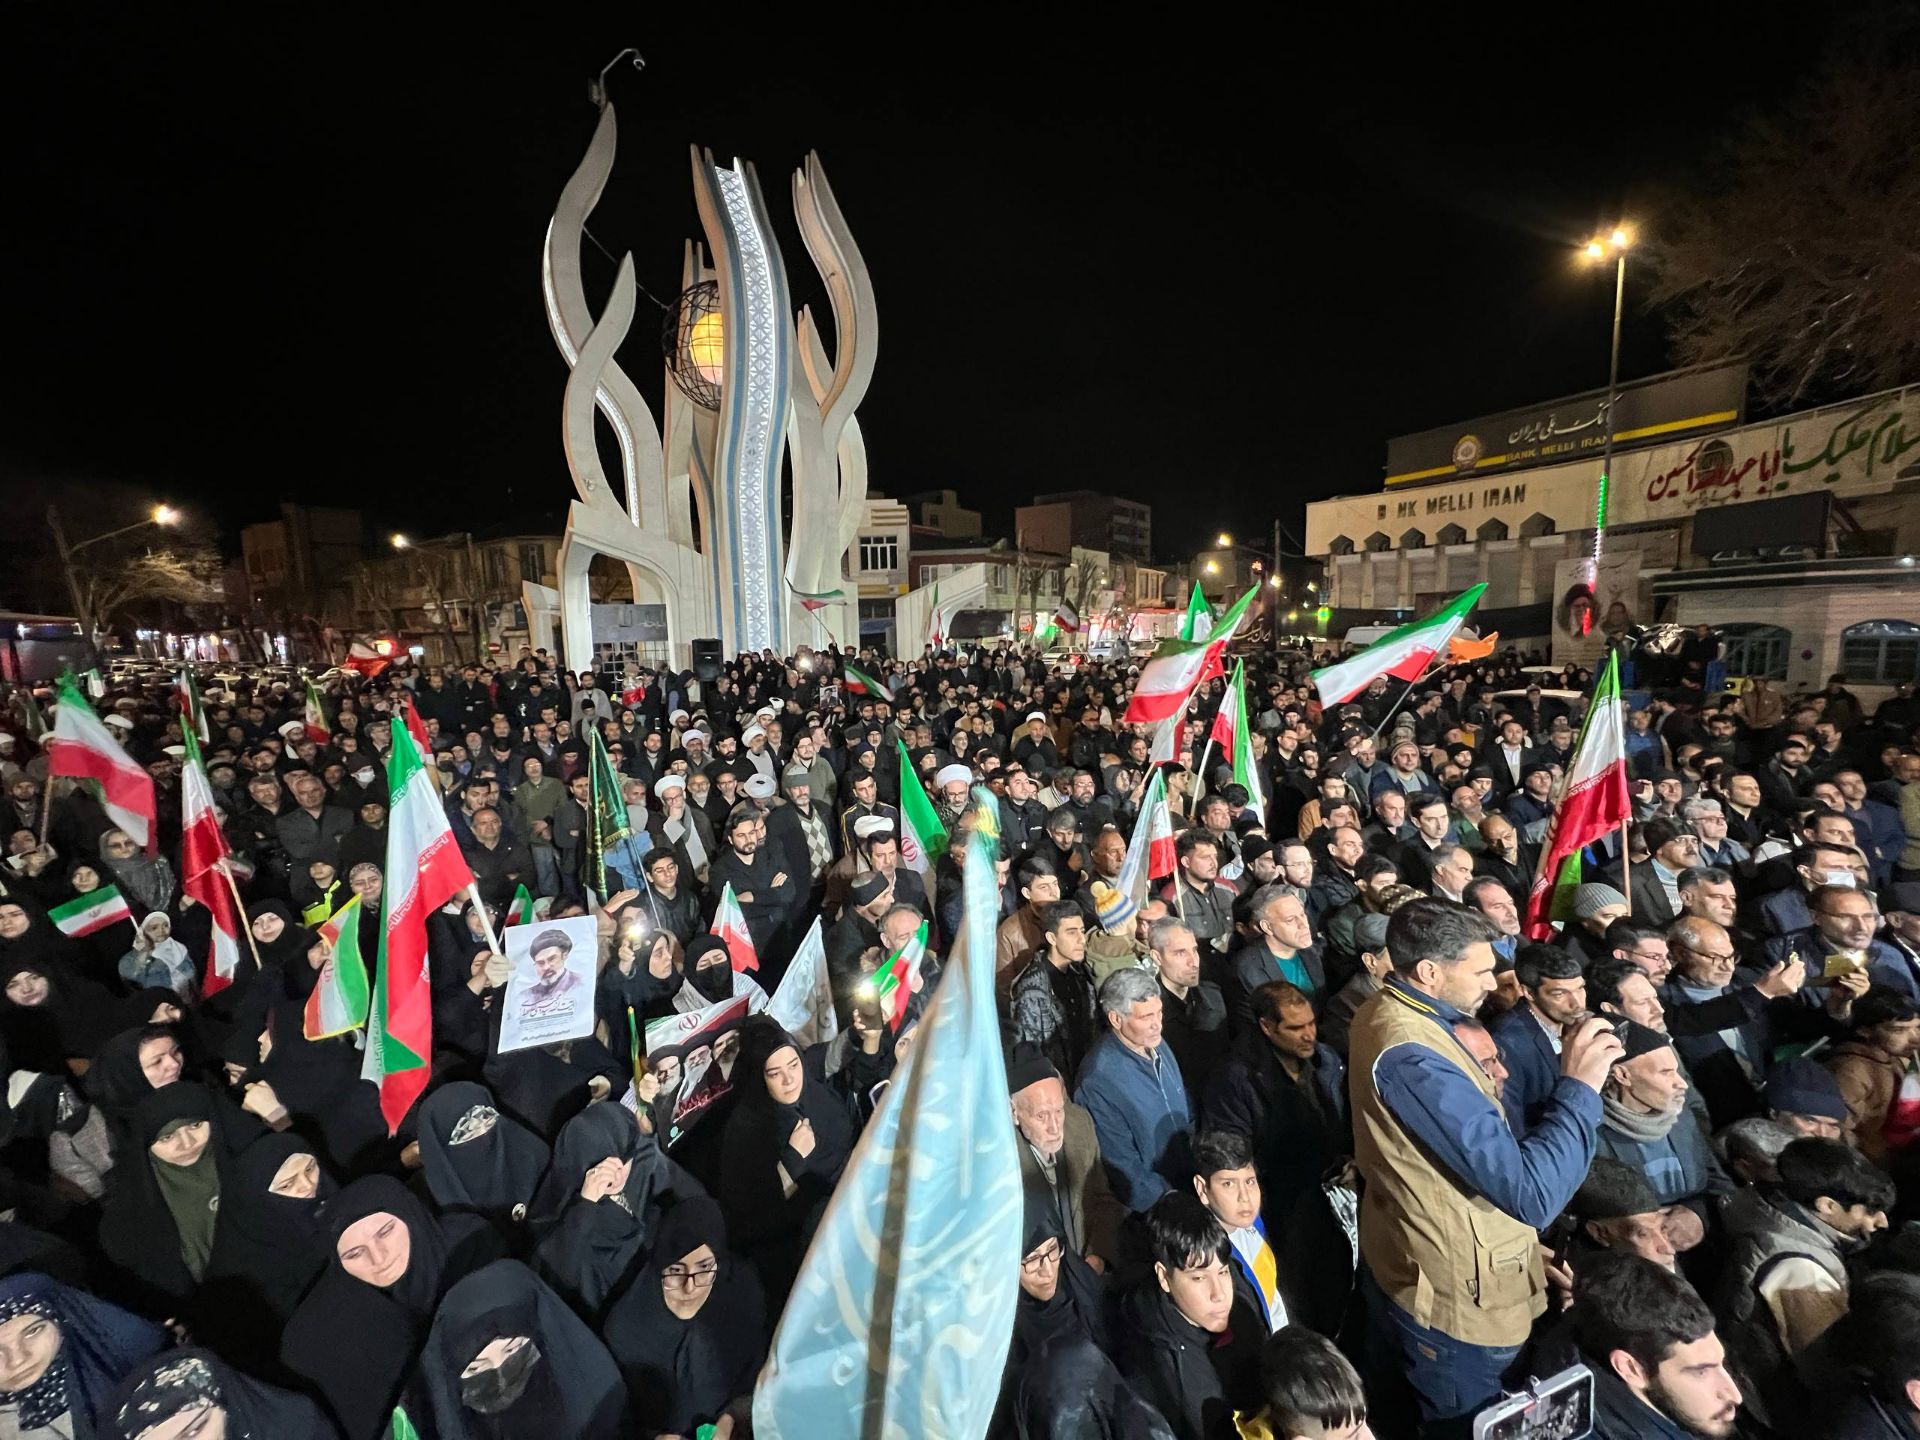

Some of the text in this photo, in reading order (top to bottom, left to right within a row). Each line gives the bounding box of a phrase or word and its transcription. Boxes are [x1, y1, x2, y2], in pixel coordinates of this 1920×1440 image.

[1508, 422, 1541, 444] ایران
[1506, 449, 1536, 462] BANK
[1541, 441, 1574, 455] MELLI
[1377, 484, 1526, 520] BNK MELLI IRAN
